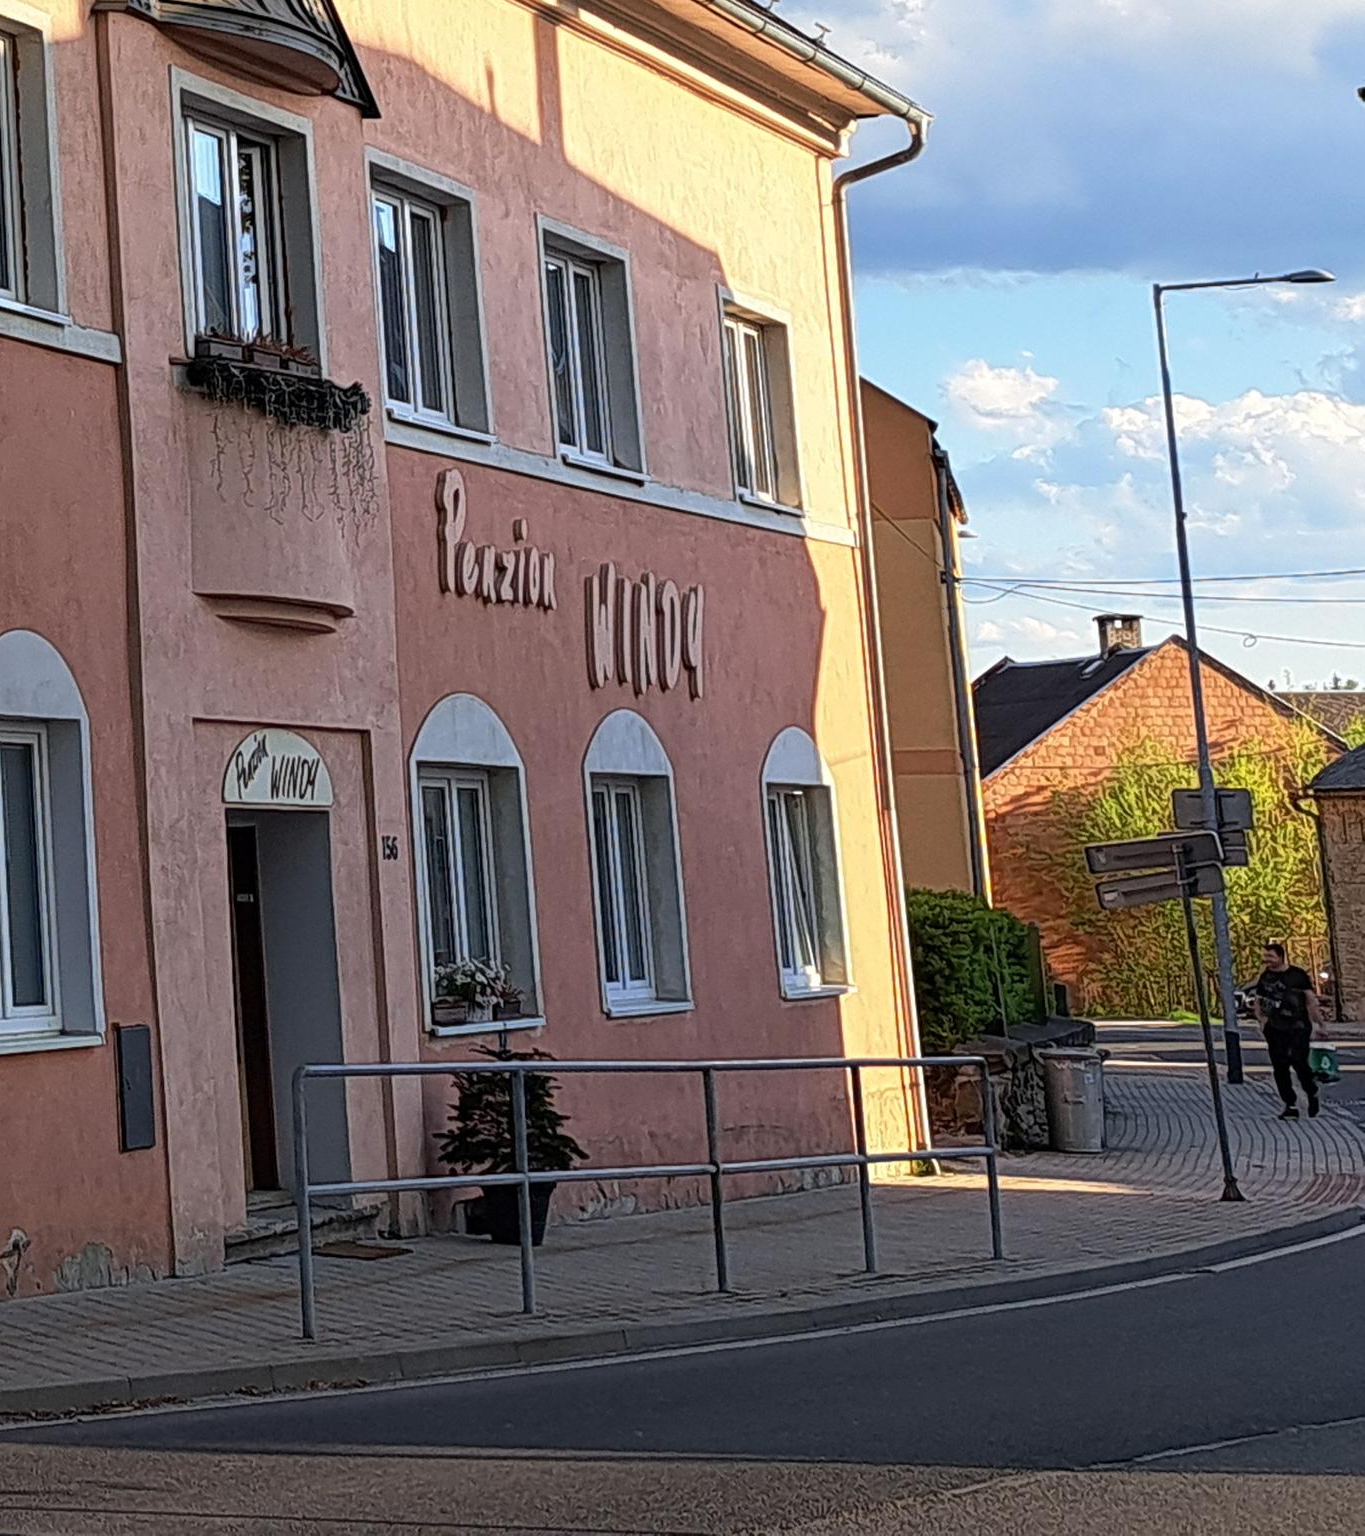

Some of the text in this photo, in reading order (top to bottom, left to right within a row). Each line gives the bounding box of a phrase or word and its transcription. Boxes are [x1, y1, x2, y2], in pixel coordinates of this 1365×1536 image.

[436, 468, 557, 611] Penzion
[585, 562, 705, 701] WINDY
[271, 754, 320, 800] WINDY
[381, 835, 398, 861] 156
